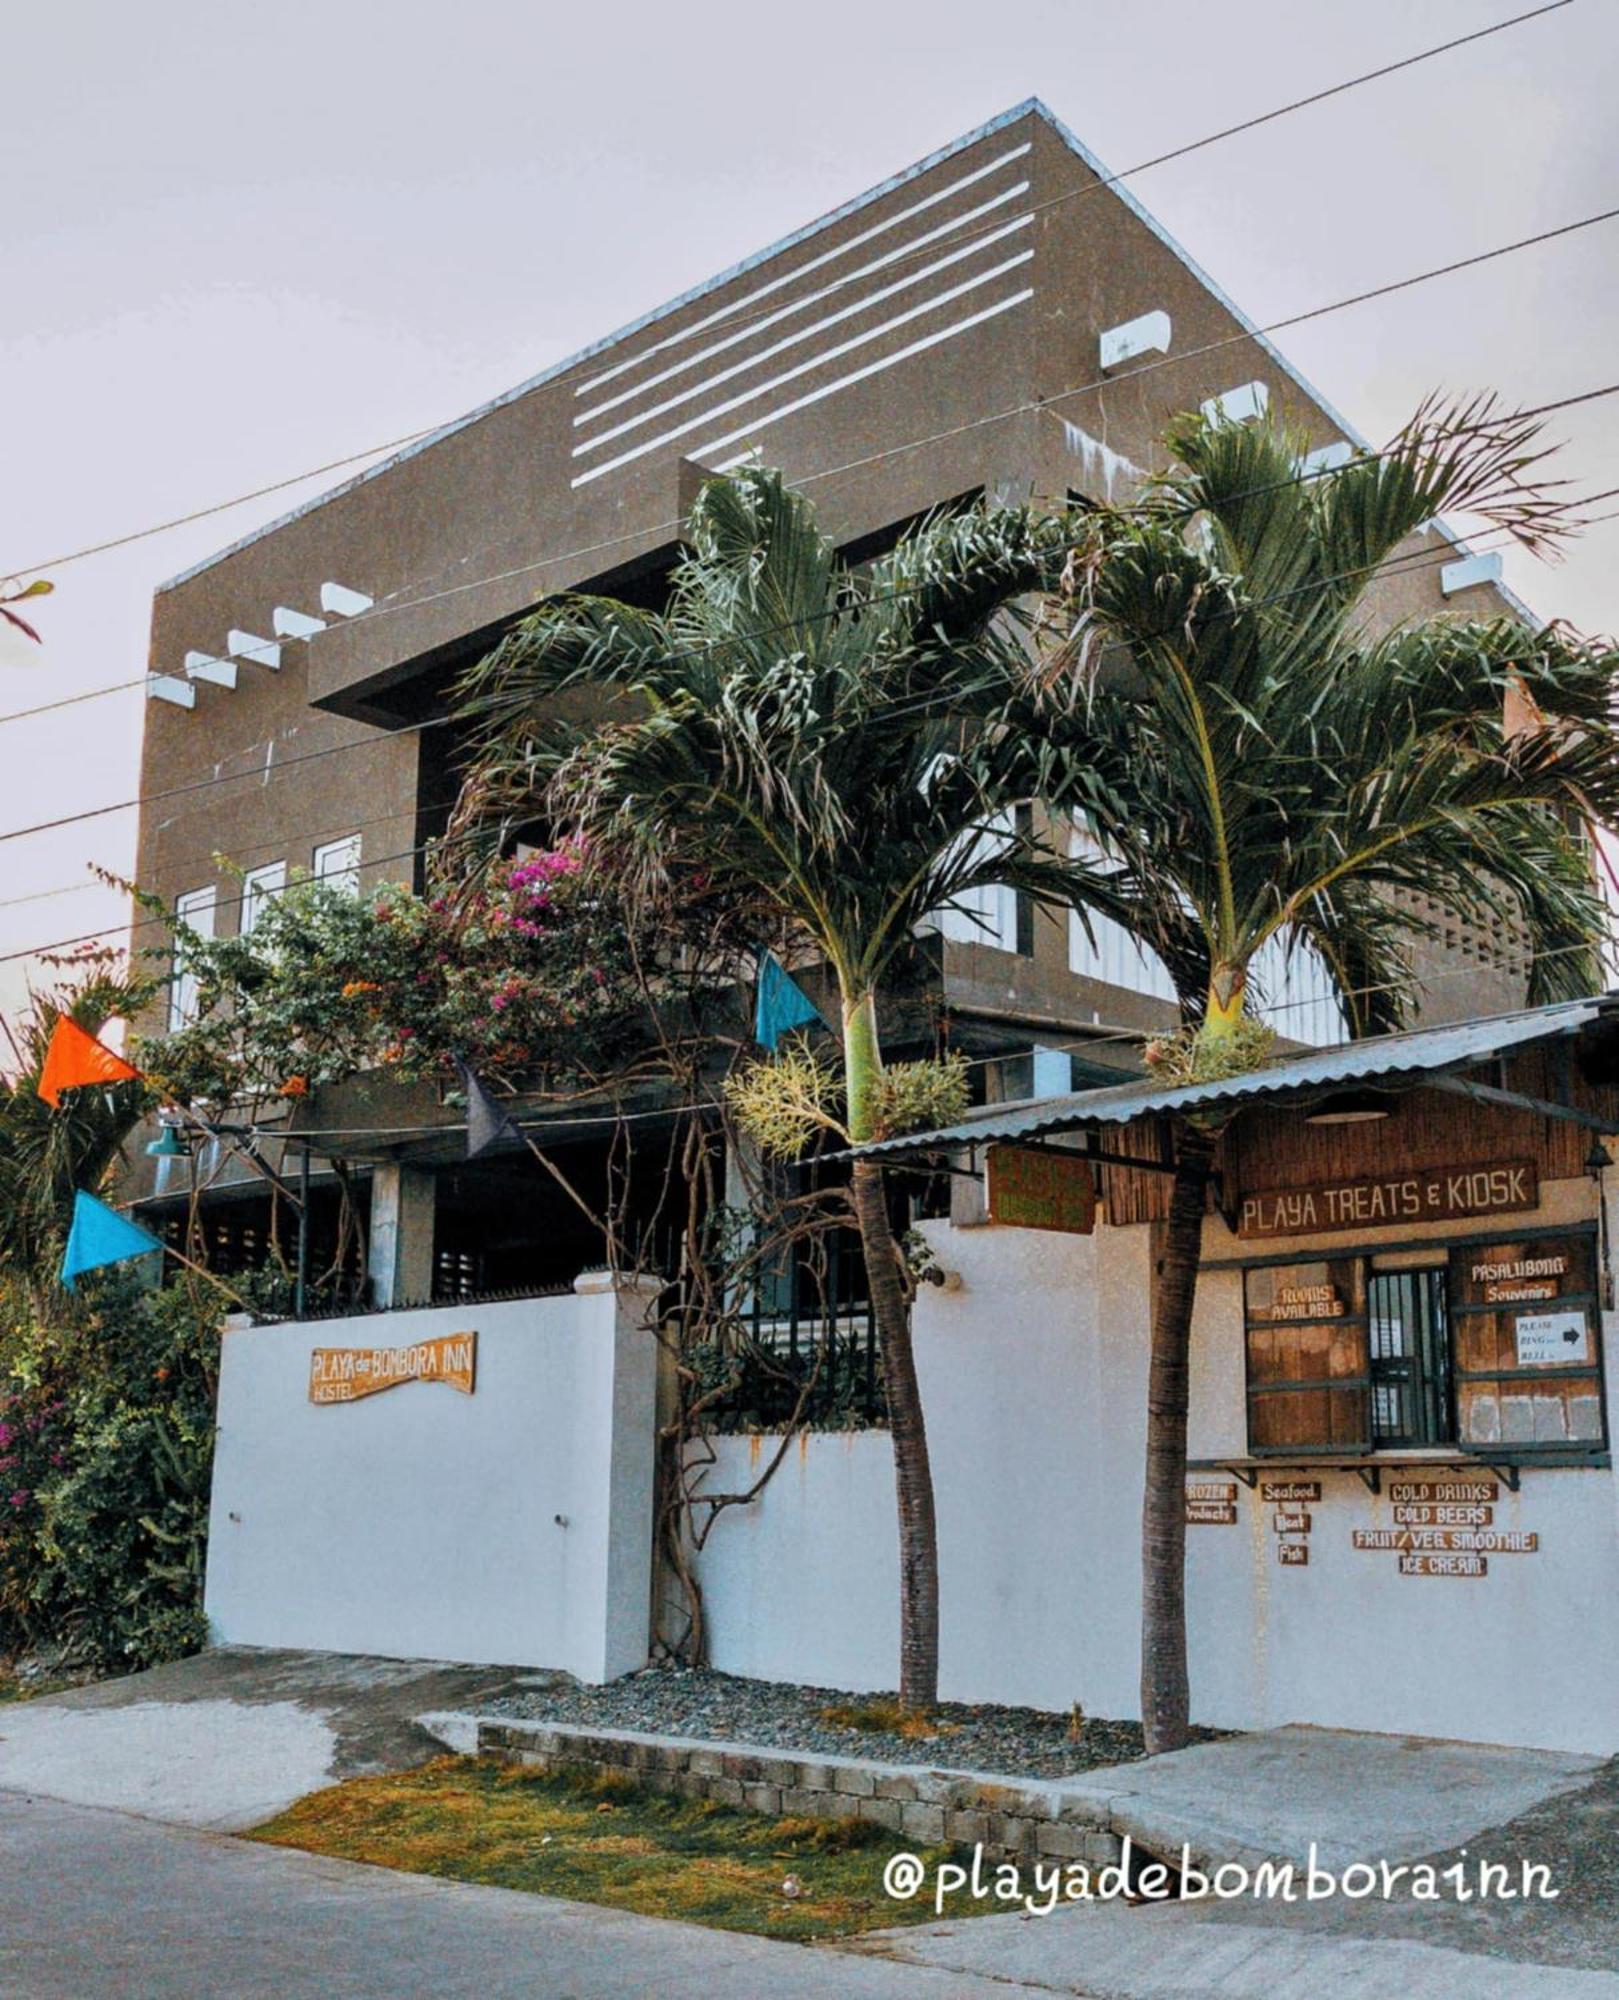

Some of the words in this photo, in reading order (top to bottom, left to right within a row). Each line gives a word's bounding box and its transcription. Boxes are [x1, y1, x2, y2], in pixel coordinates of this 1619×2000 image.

[1243, 1193, 1317, 1231] PLAYA
[1324, 1181, 1419, 1223] TREATS
[1448, 1168, 1527, 1210] KIOSK
[1472, 1256, 1565, 1282] PASALUBONG
[1282, 1285, 1331, 1303] ROOMS
[1488, 1285, 1553, 1302] Souvenirs
[1271, 1301, 1344, 1320] AVAILABLE
[313, 1354, 356, 1382] PLAYA
[372, 1347, 437, 1378] BOMBORA
[443, 1342, 473, 1372] INN
[314, 1383, 353, 1401] HOSTEL
[1265, 1483, 1314, 1500] Seafood
[1391, 1484, 1430, 1500] COLD
[1436, 1483, 1492, 1500] DRINKS
[1275, 1514, 1305, 1531] Meat
[1396, 1507, 1431, 1523] COLD
[1436, 1507, 1486, 1524] BEERS
[1451, 1532, 1533, 1550] SMOOTHIE
[1280, 1545, 1304, 1561] Fish
[1402, 1557, 1424, 1573] ICE
[1429, 1557, 1483, 1574] CREAM
